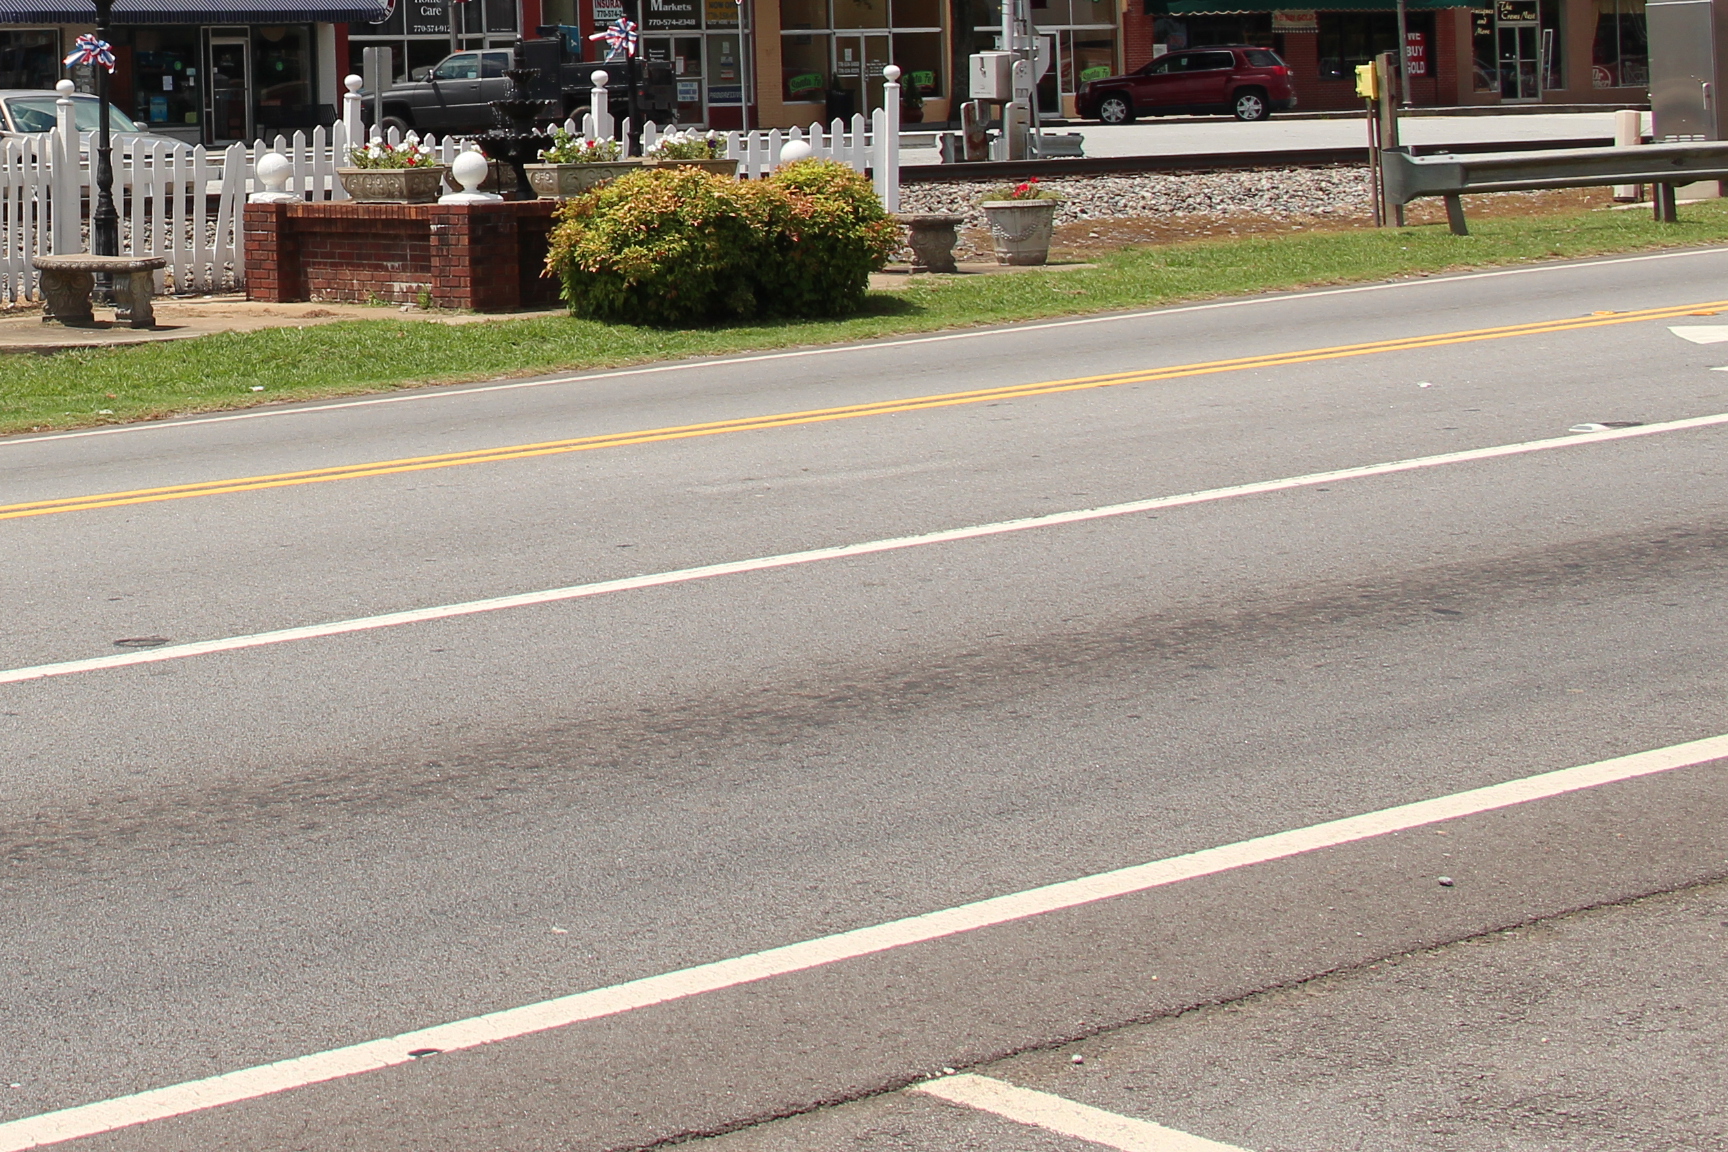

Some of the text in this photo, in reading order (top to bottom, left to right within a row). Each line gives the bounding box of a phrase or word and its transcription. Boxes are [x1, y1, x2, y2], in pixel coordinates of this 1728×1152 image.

[594, 0, 622, 8] INSURAN
[651, 0, 692, 11] Markets
[1498, 1, 1512, 11] The
[420, 6, 442, 16] Care
[597, 10, 622, 18] 770-574-2
[1474, 28, 1491, 36] More
[1406, 46, 1424, 56] BUY
